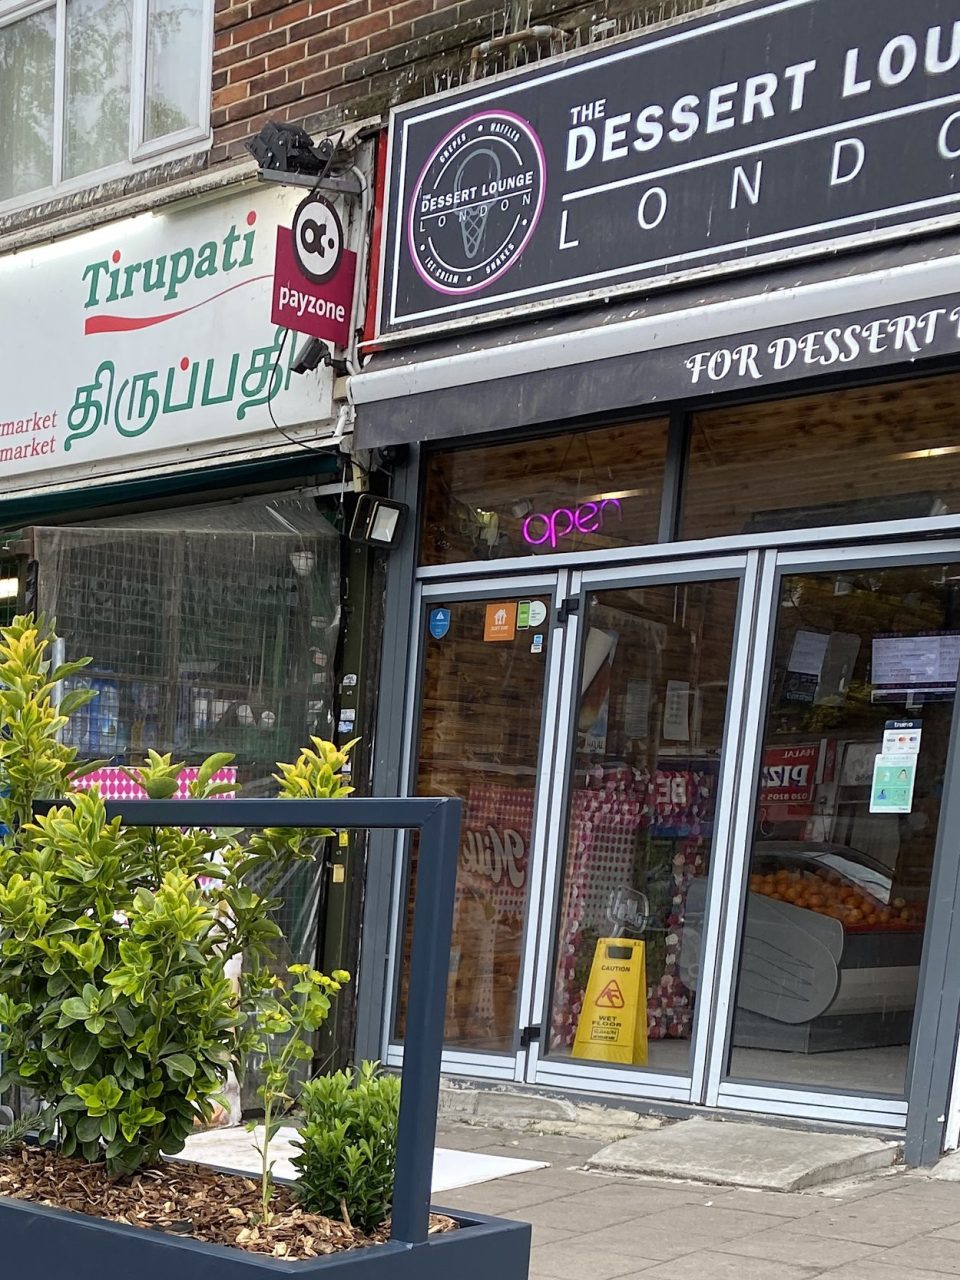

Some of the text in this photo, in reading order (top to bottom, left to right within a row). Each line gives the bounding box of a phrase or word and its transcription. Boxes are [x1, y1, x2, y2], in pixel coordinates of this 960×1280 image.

[566, 59, 816, 172] DESSERT
[570, 98, 606, 125] THE
[439, 133, 467, 163] CREPES
[490, 122, 521, 142] WAFFLES
[421, 171, 534, 212] DESSERT LOUNGE
[419, 193, 531, 233] LONDON
[81, 210, 257, 309] Tirupati
[485, 243, 515, 274] SHAKES
[278, 285, 346, 323] payzone
[686, 343, 763, 384] FOR
[767, 308, 947, 370] DESSERT
[64, 325, 297, 452] திருப்பதி
[522, 498, 623, 548] open
[601, 965, 631, 973] CAUTION
[591, 1020, 622, 1028] FLOOR
